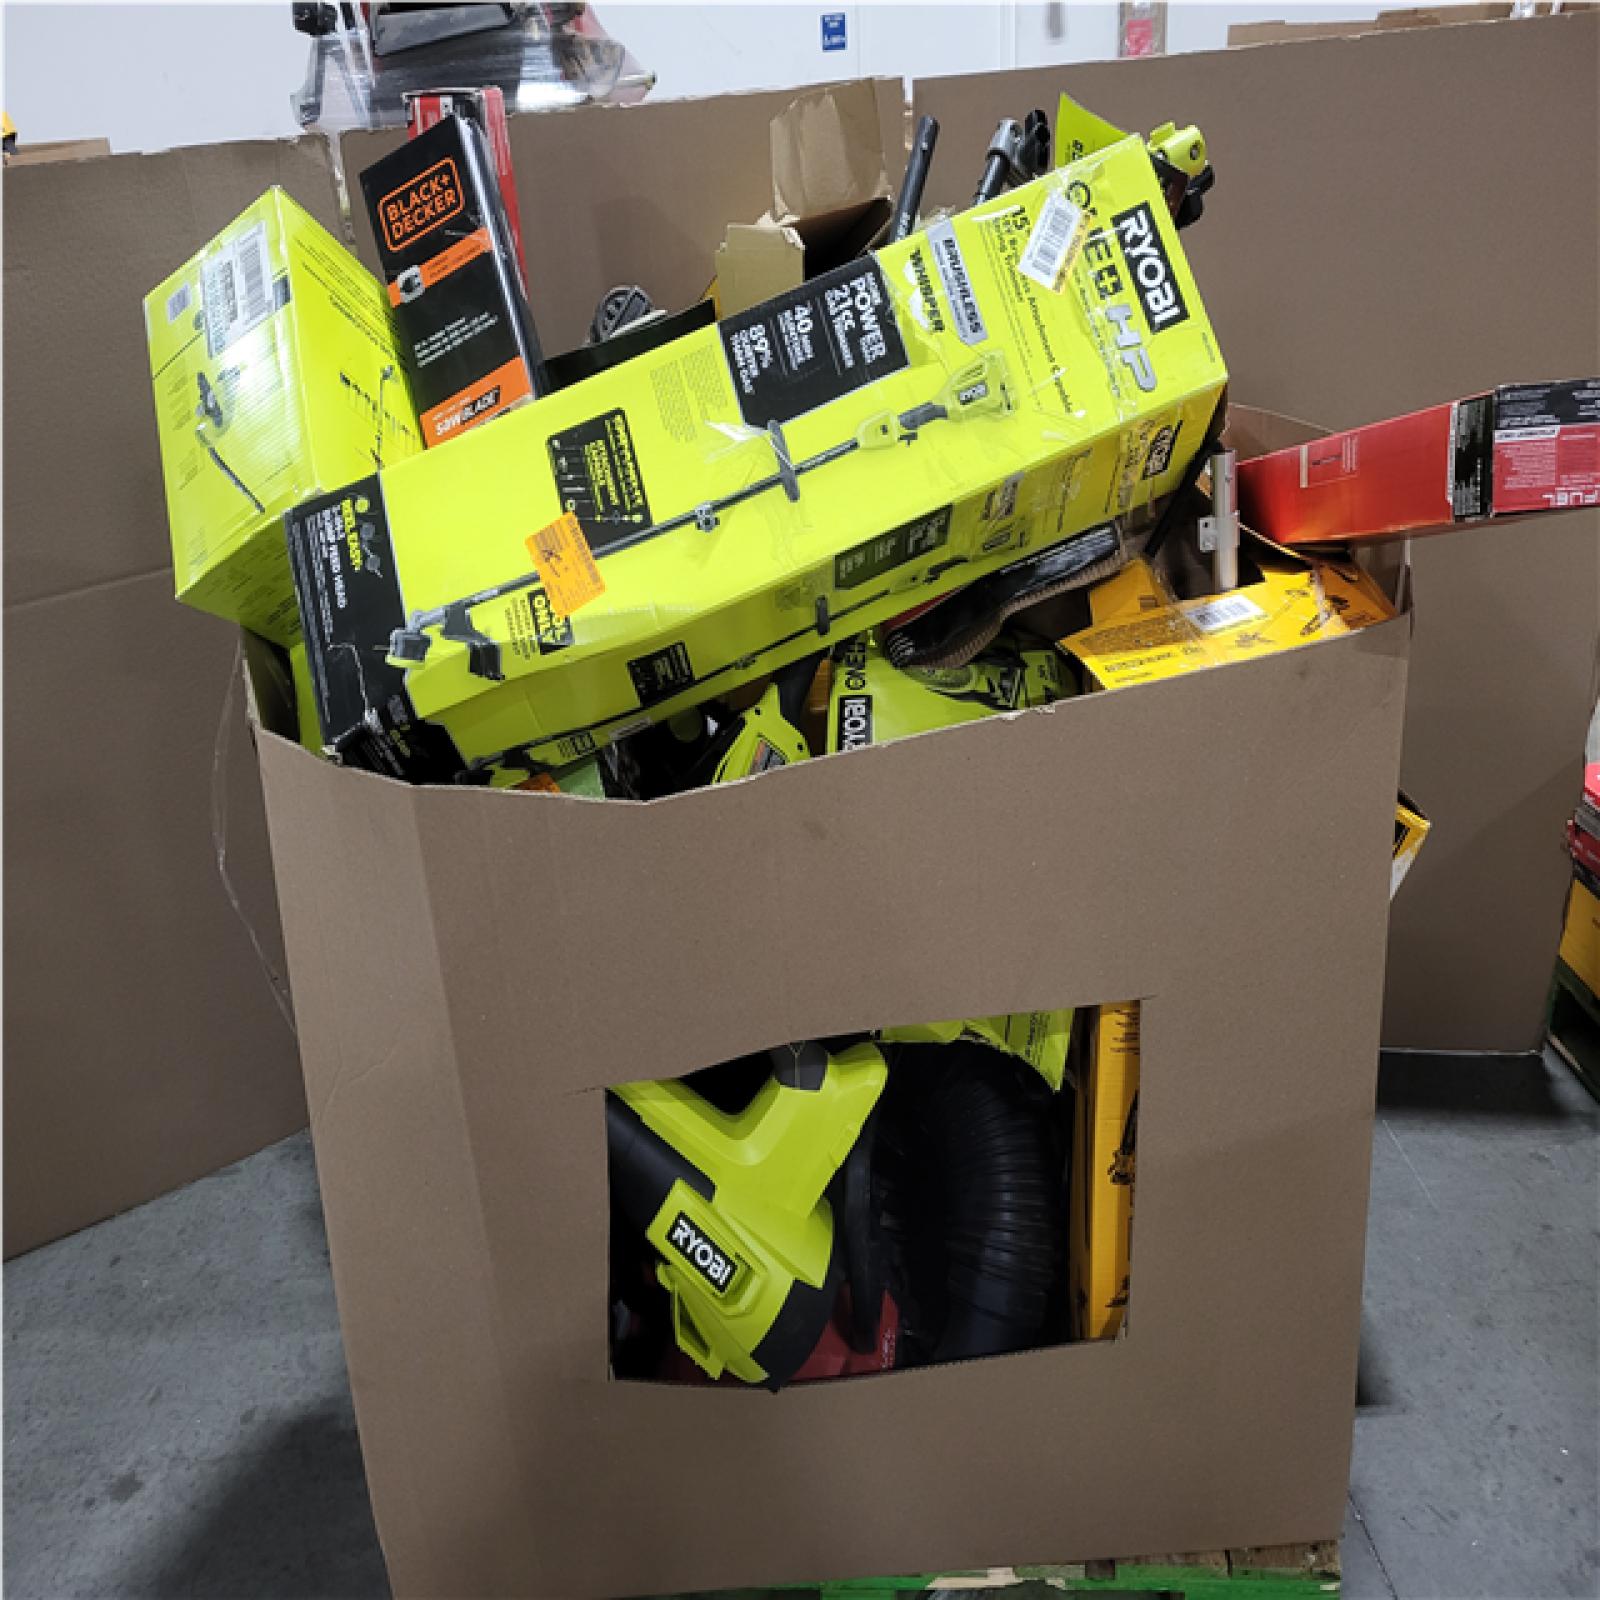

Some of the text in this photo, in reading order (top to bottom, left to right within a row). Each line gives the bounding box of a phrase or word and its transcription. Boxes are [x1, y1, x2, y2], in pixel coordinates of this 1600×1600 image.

[386, 174, 450, 221] BLACK+
[391, 189, 456, 240] DECKER
[909, 246, 946, 333] WHISPER
[942, 239, 984, 333] BRUSHLESS
[1115, 208, 1182, 325] RYOBI
[794, 303, 814, 334] 40
[834, 284, 857, 331] 21cc
[849, 276, 886, 358] POWER
[749, 324, 773, 369] 89%
[1106, 303, 1157, 394] HP
[533, 594, 557, 642] ONLY
[671, 1217, 731, 1286] RYOBI
